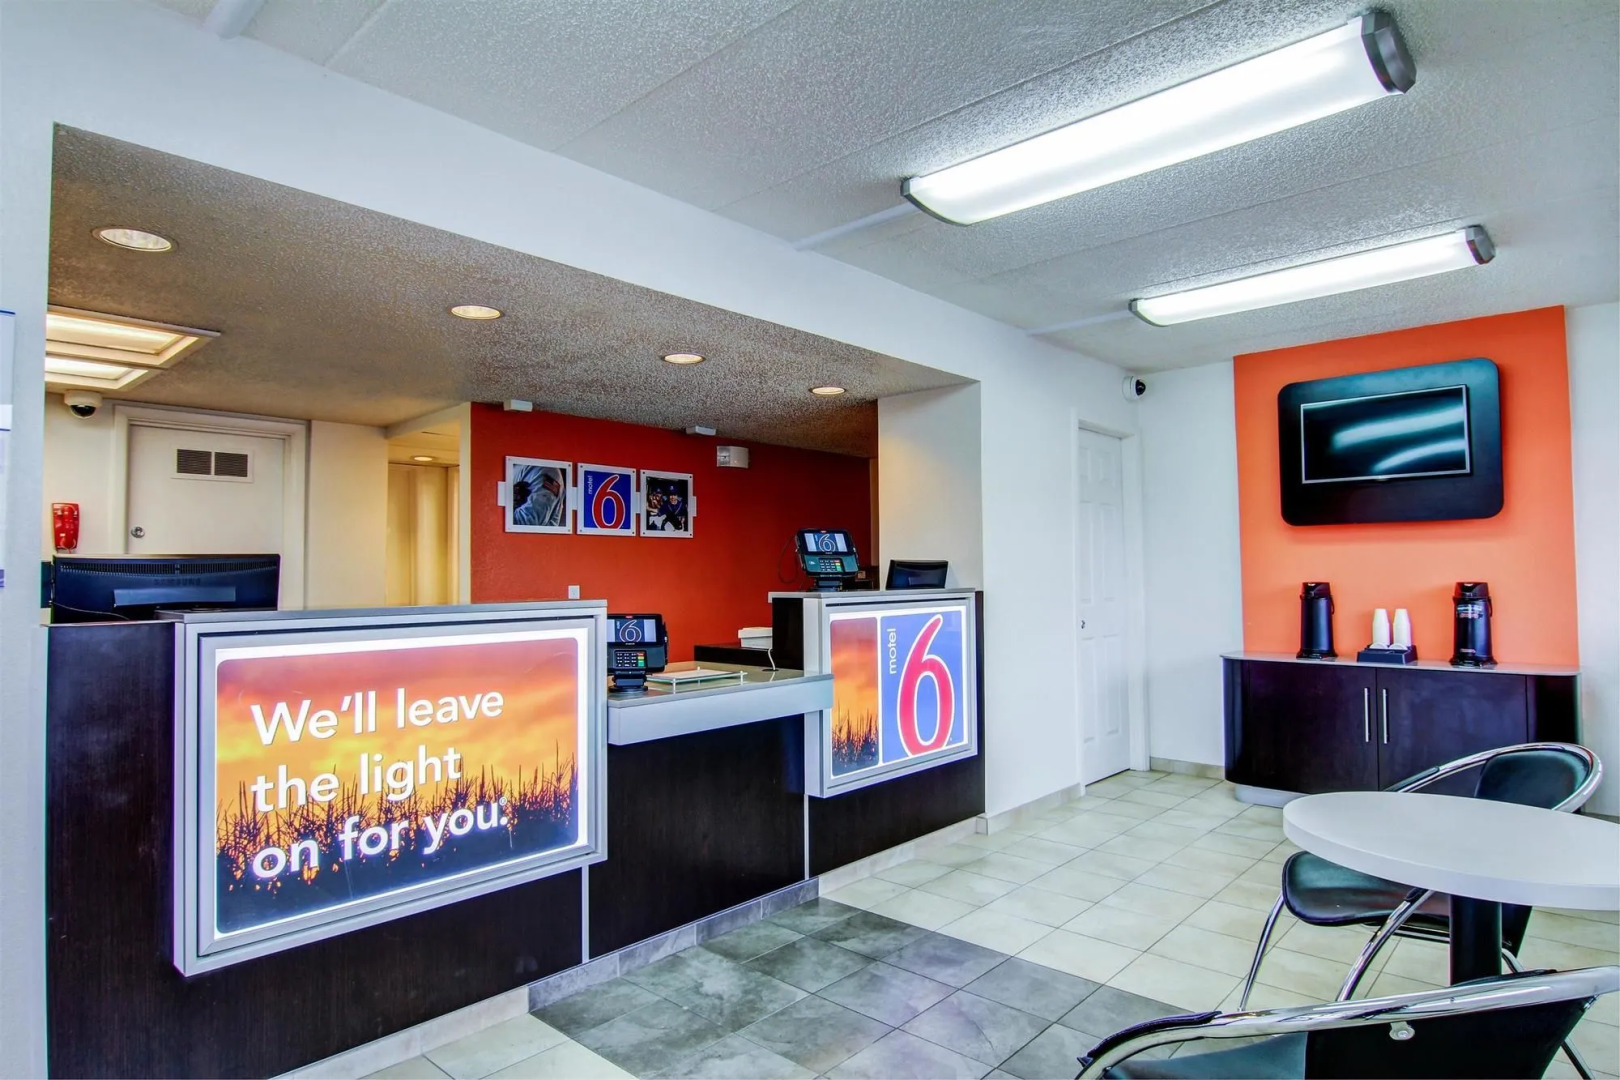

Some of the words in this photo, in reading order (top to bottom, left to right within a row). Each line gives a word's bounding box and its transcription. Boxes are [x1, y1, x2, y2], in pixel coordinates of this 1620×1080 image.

[592, 474, 625, 529] 6
[819, 533, 836, 552] 6
[620, 620, 642, 642] 6
[889, 627, 897, 675] motel
[897, 614, 954, 757] 6
[250, 689, 377, 746] We'll
[396, 687, 504, 729] leave
[250, 764, 339, 812] the
[360, 744, 462, 801] light
[252, 838, 319, 878] on
[339, 815, 408, 861] for
